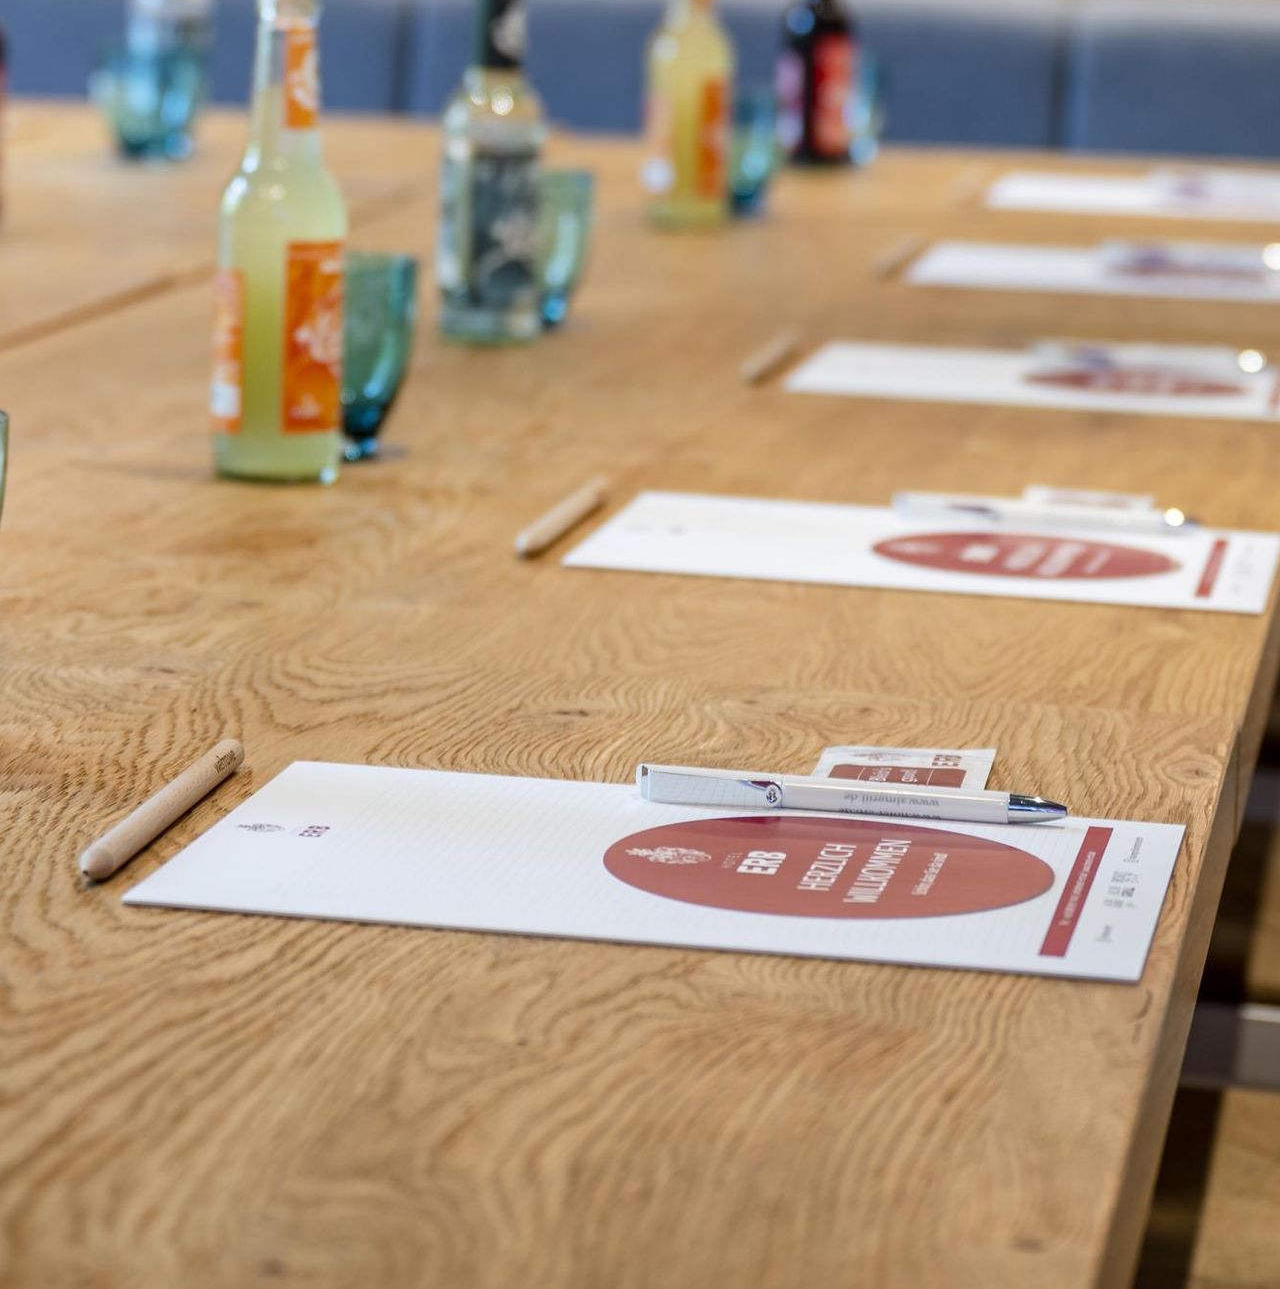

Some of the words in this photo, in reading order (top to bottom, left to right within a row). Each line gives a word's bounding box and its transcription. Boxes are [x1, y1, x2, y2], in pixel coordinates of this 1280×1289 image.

[736, 850, 787, 875] ERB
[796, 842, 857, 891] HERZLICH
[842, 838, 912, 903] WILLKOMMEN
